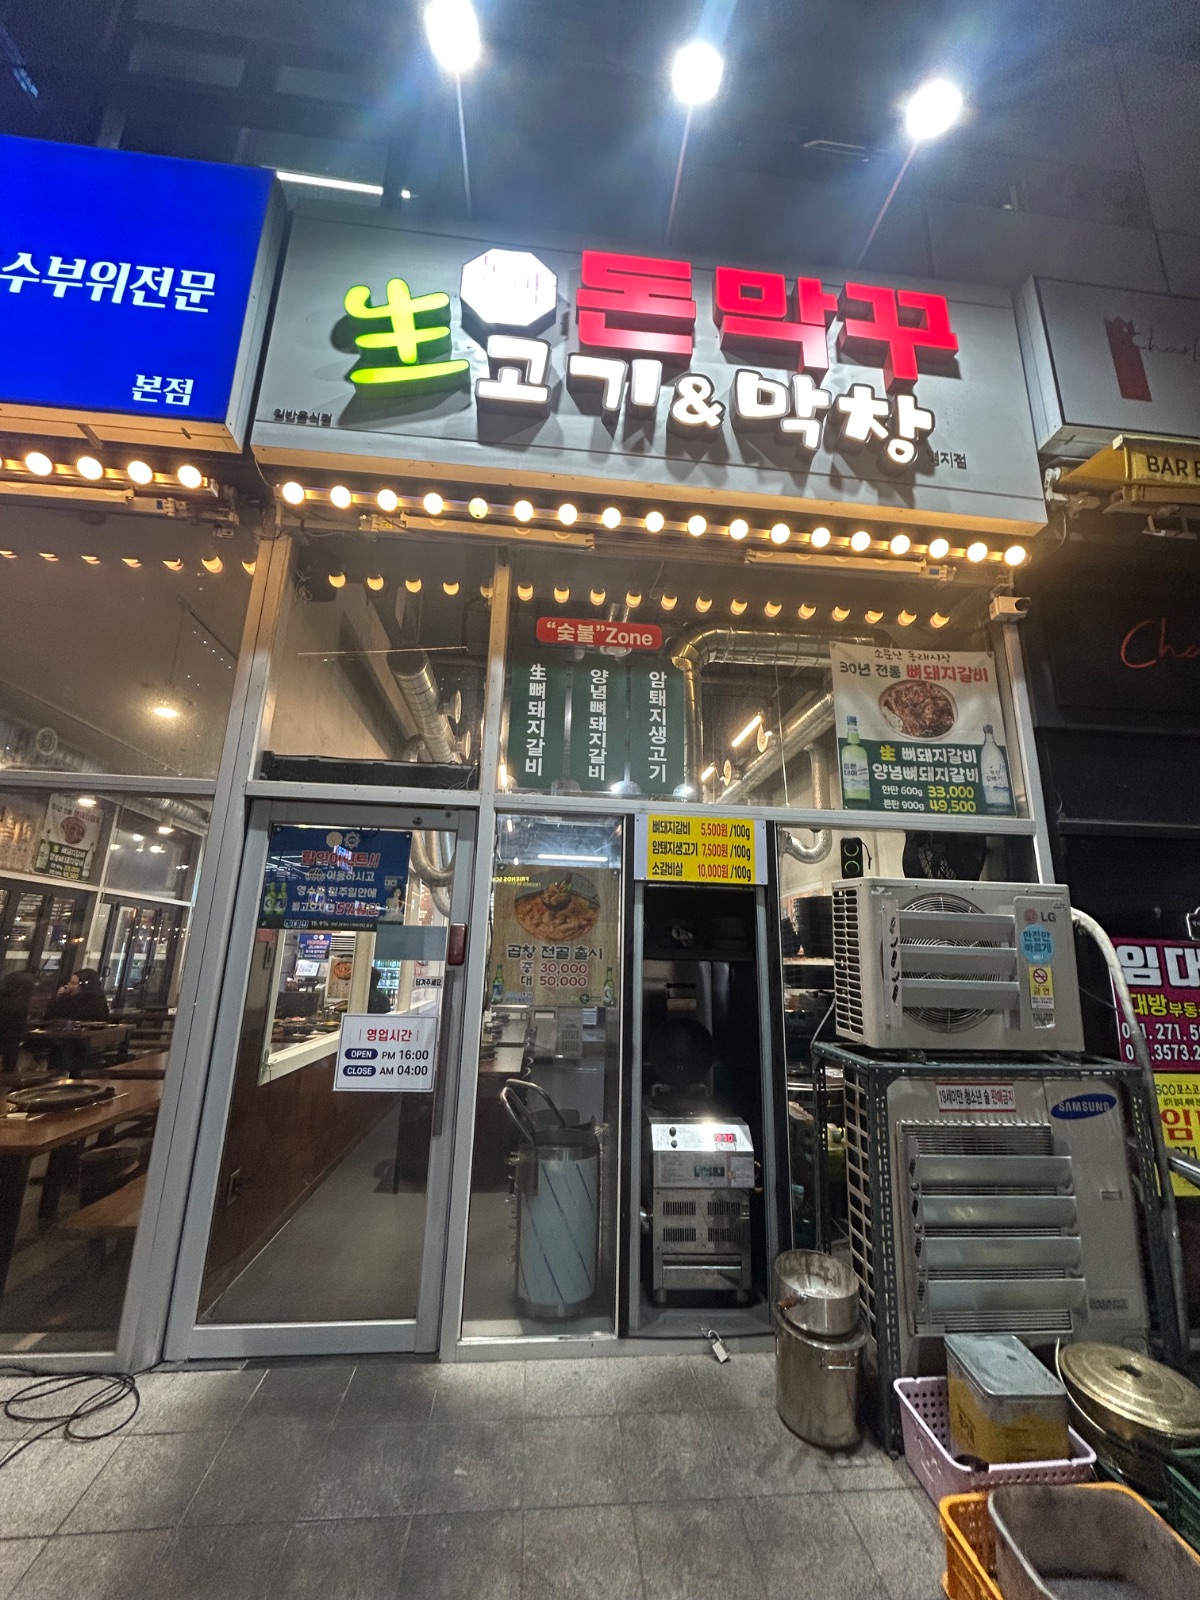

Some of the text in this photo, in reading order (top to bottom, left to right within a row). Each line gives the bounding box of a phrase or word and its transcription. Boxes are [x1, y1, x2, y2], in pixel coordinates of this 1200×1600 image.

[132, 374, 194, 406] 본점
[1146, 455, 1188, 478] BAR
[874, 648, 951, 663] 소문난 동래시장
[840, 661, 871, 676] 30년
[875, 664, 901, 679] 전통
[588, 669, 609, 781] 양념뼈돼지갈비
[901, 786, 923, 796] 600g
[928, 785, 975, 798] 33,000
[902, 801, 925, 811] 900g
[929, 800, 976, 813] 49,500
[701, 823, 728, 838] 5,500원
[729, 824, 751, 840] /100g
[702, 843, 728, 858] 7,500원
[730, 845, 751, 861] /100g
[652, 861, 751, 882] 소갈비살 10,000원 /100g
[1040, 912, 1057, 922] LG
[507, 944, 603, 960] 곱창 전골 출시
[522, 961, 588, 975] 중 30,000
[520, 975, 587, 988] 대 50,000
[366, 1029, 412, 1042] 영업시간
[351, 1050, 429, 1060] OPEN PM 16:00
[347, 1065, 428, 1076] CLOSE AM 04:00
[1058, 1101, 1110, 1112] SAMSUNG
